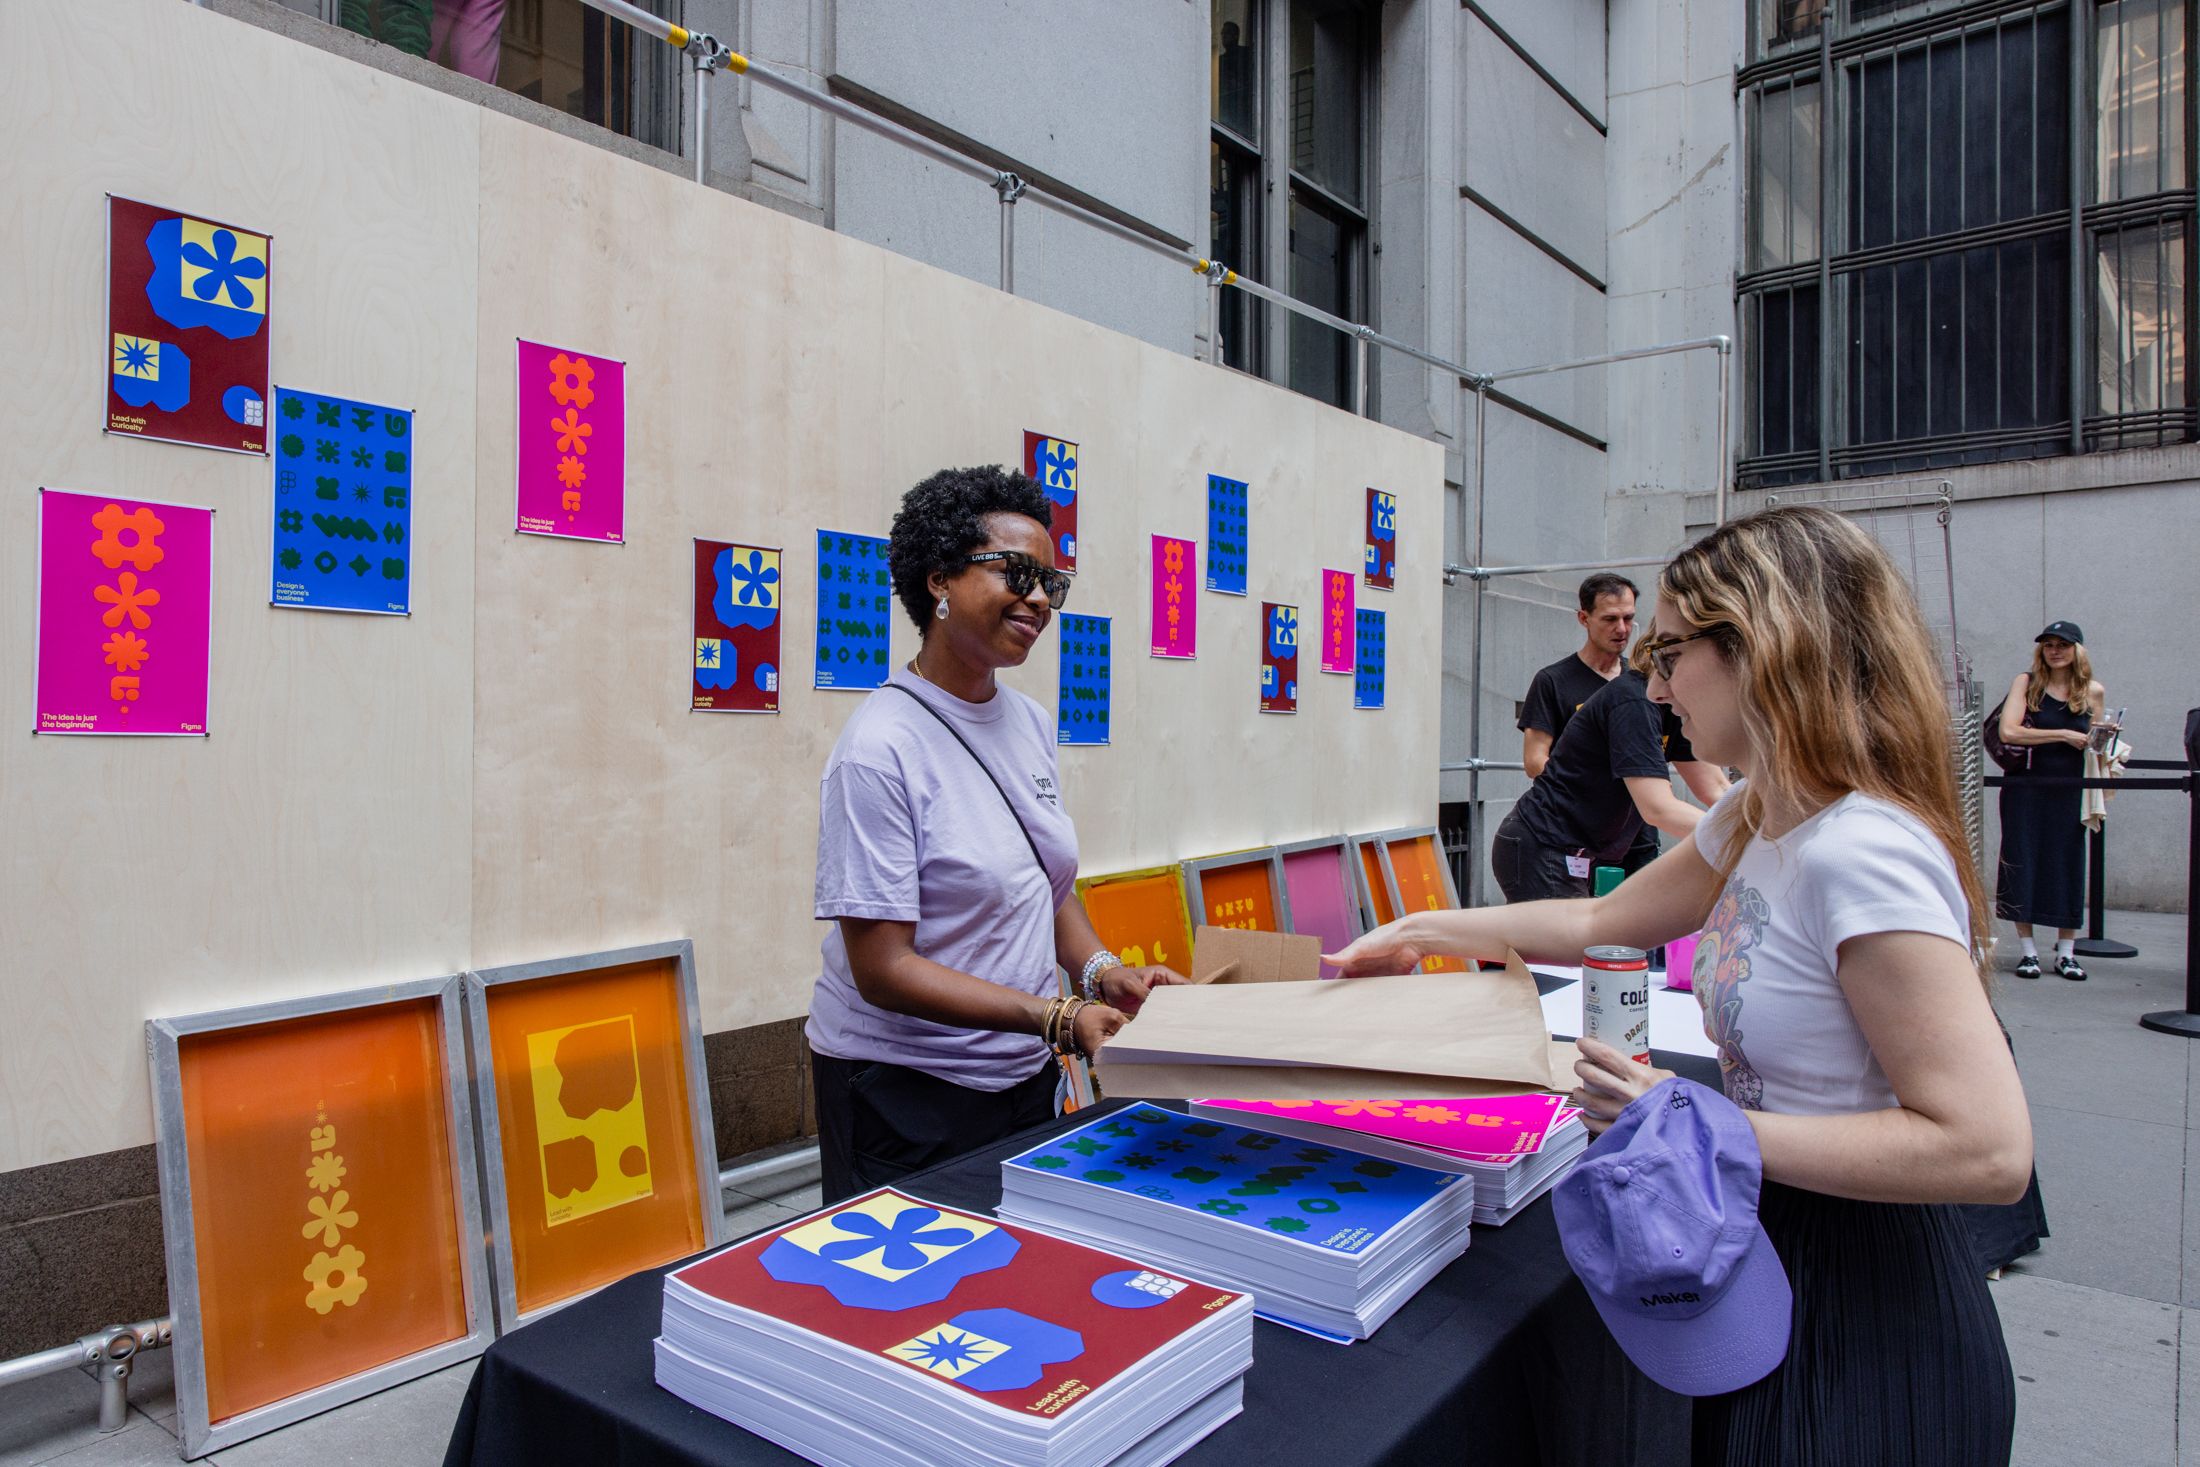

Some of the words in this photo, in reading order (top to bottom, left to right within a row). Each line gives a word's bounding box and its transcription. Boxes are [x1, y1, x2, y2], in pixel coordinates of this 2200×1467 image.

[111, 413, 130, 423] Lead
[130, 416, 147, 425] with
[111, 421, 143, 433] curiosity
[242, 440, 263, 450] Figma
[276, 581, 298, 590] Design
[276, 588, 310, 597] everyone's
[276, 594, 305, 602] business
[387, 602, 405, 611] Figma
[42, 713, 57, 721] The
[58, 713, 75, 721] idea
[76, 713, 83, 721] is
[83, 713, 98, 724] just
[41, 720, 55, 728] the
[55, 721, 94, 730] beginning
[180, 723, 202, 732] Figma
[1320, 1231, 1345, 1246] Design
[1202, 1295, 1232, 1310] Figma
[1640, 1291, 1700, 1307] Maker
[1025, 1392, 1059, 1410] Lead
[1053, 1379, 1081, 1394] with
[1044, 1384, 1090, 1414] curiosity
